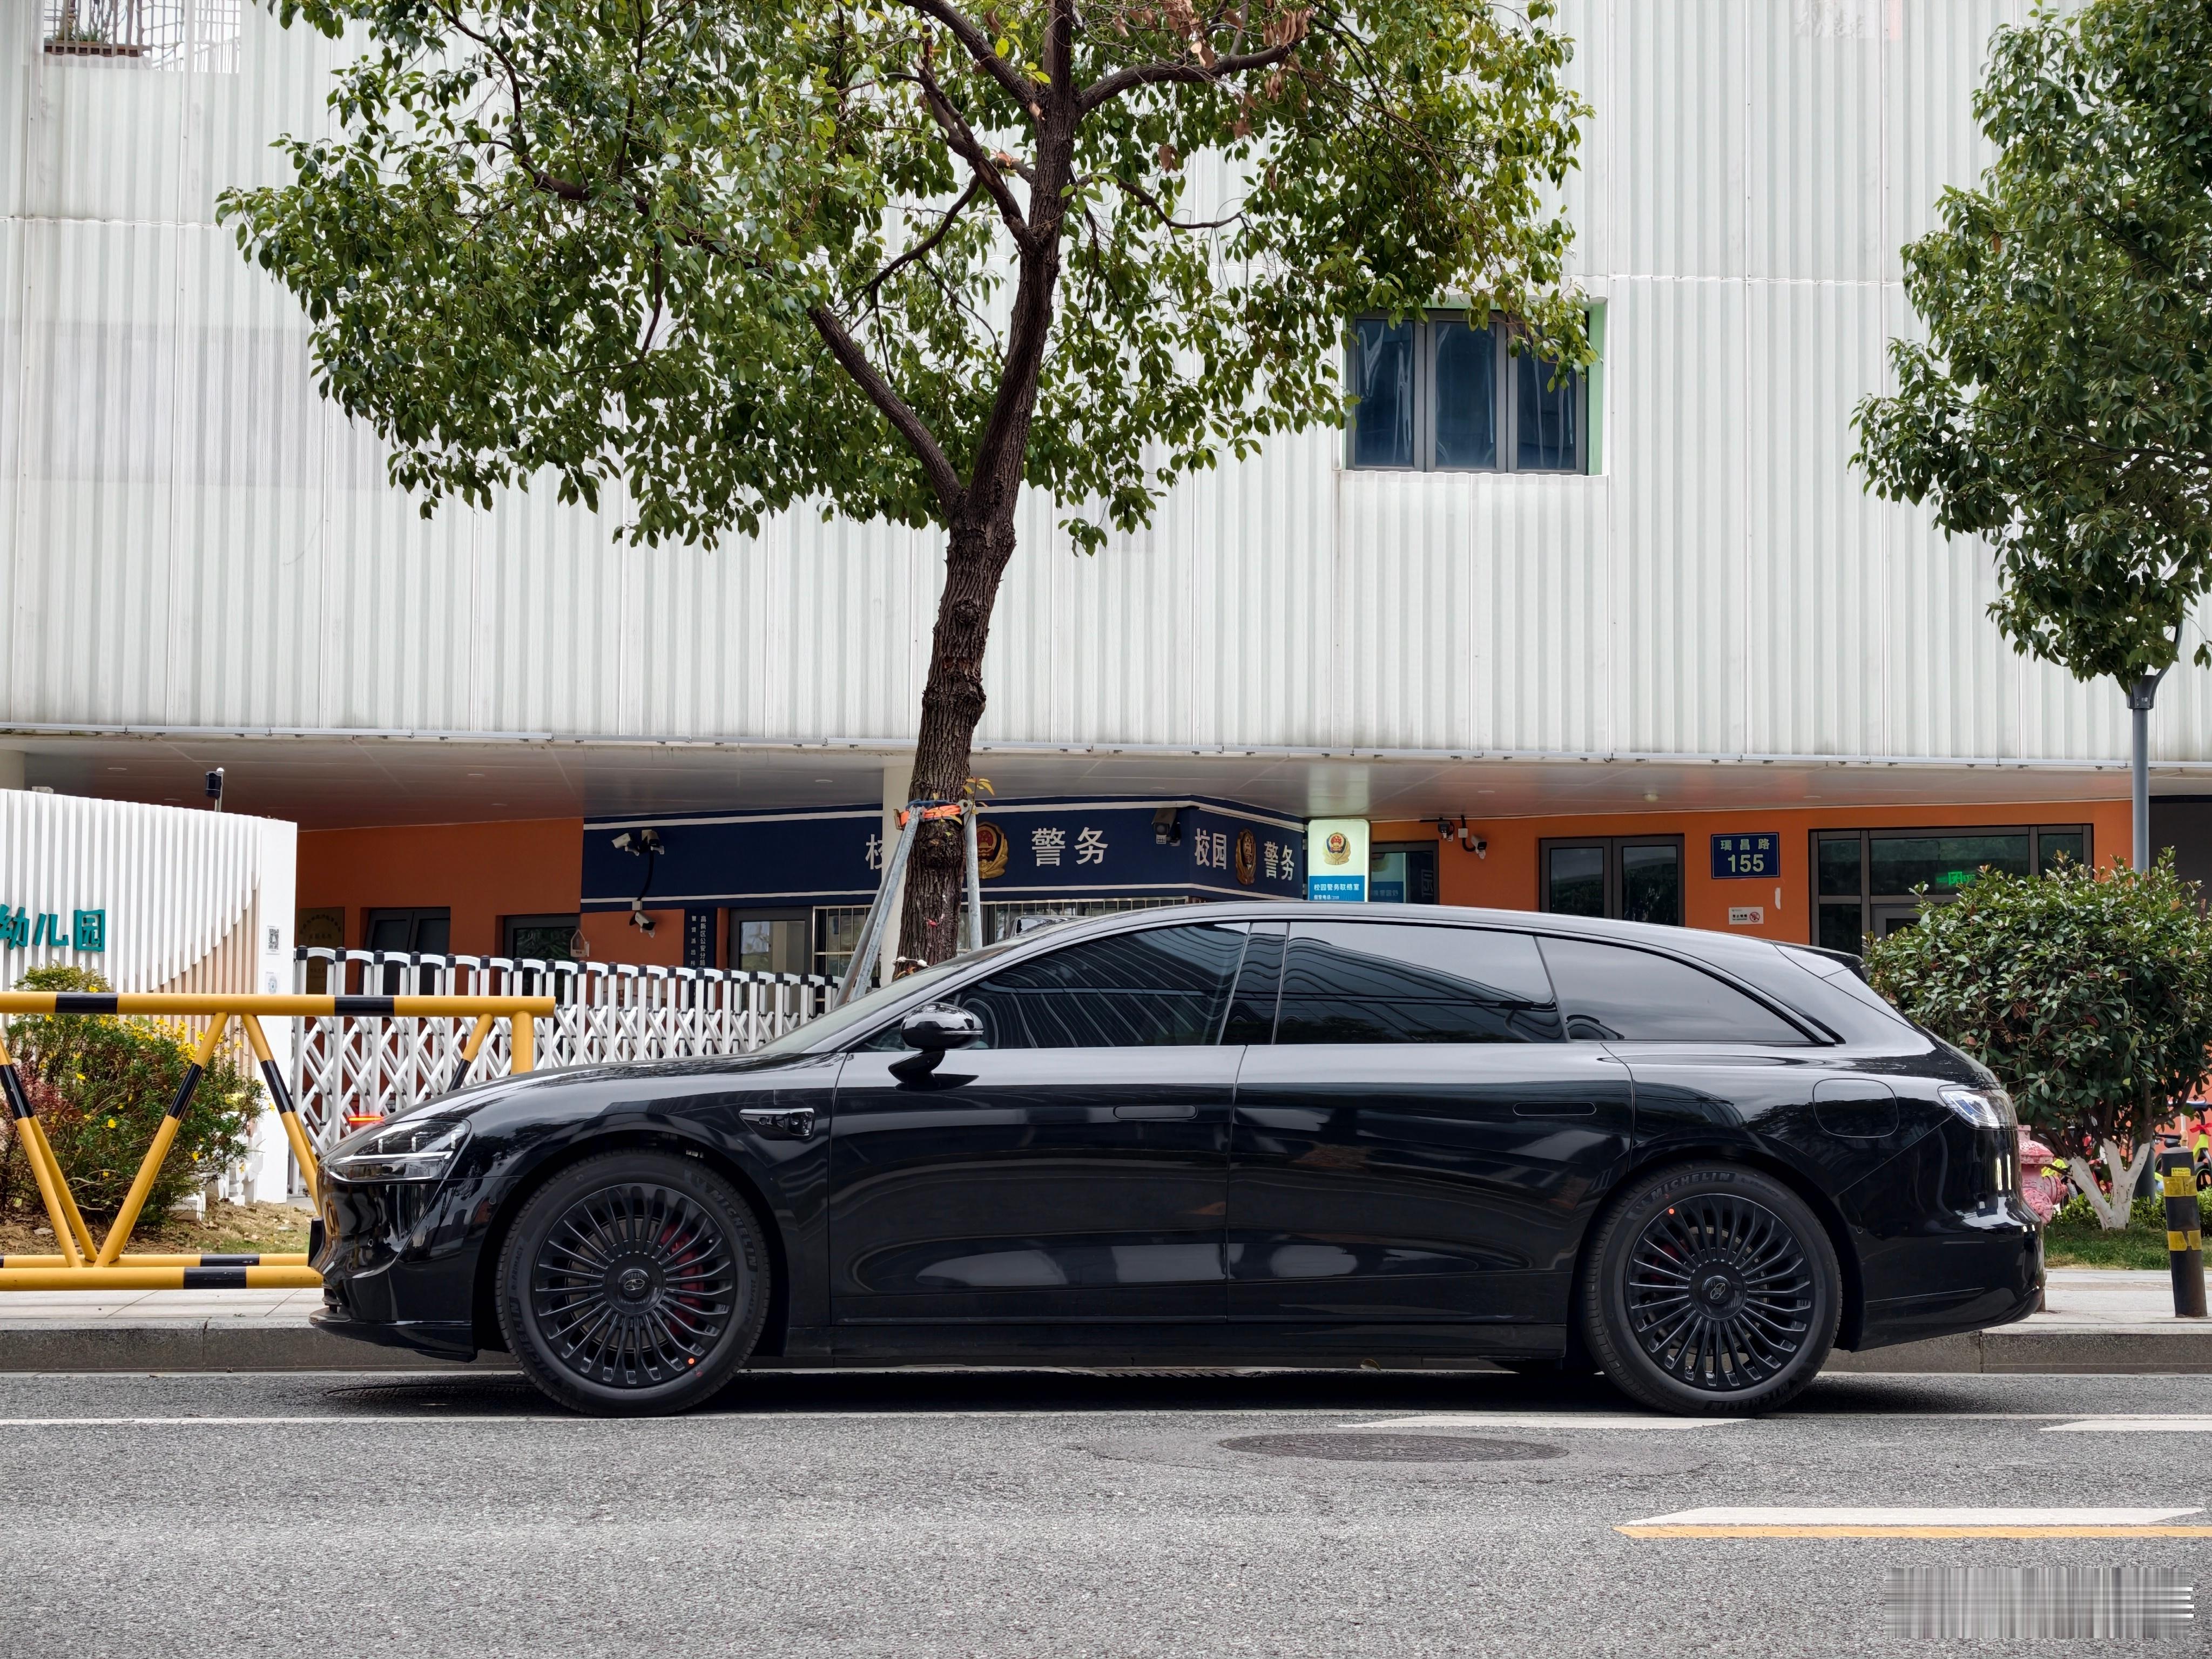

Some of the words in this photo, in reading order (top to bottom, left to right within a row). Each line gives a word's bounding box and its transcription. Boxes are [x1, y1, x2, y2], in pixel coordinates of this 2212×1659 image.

[1031, 827, 1108, 867] 警务
[1195, 828, 1228, 870] 校园
[1264, 840, 1294, 881] 警务
[1720, 838, 1770, 851] 瑞昌路
[1728, 854, 1764, 873] 155
[0, 904, 105, 952] 幼儿园
[1650, 1172, 1730, 1201] MICHELIN
[709, 1189, 758, 1267] MICHELIN
[509, 1301, 559, 1381] MICHELIN
